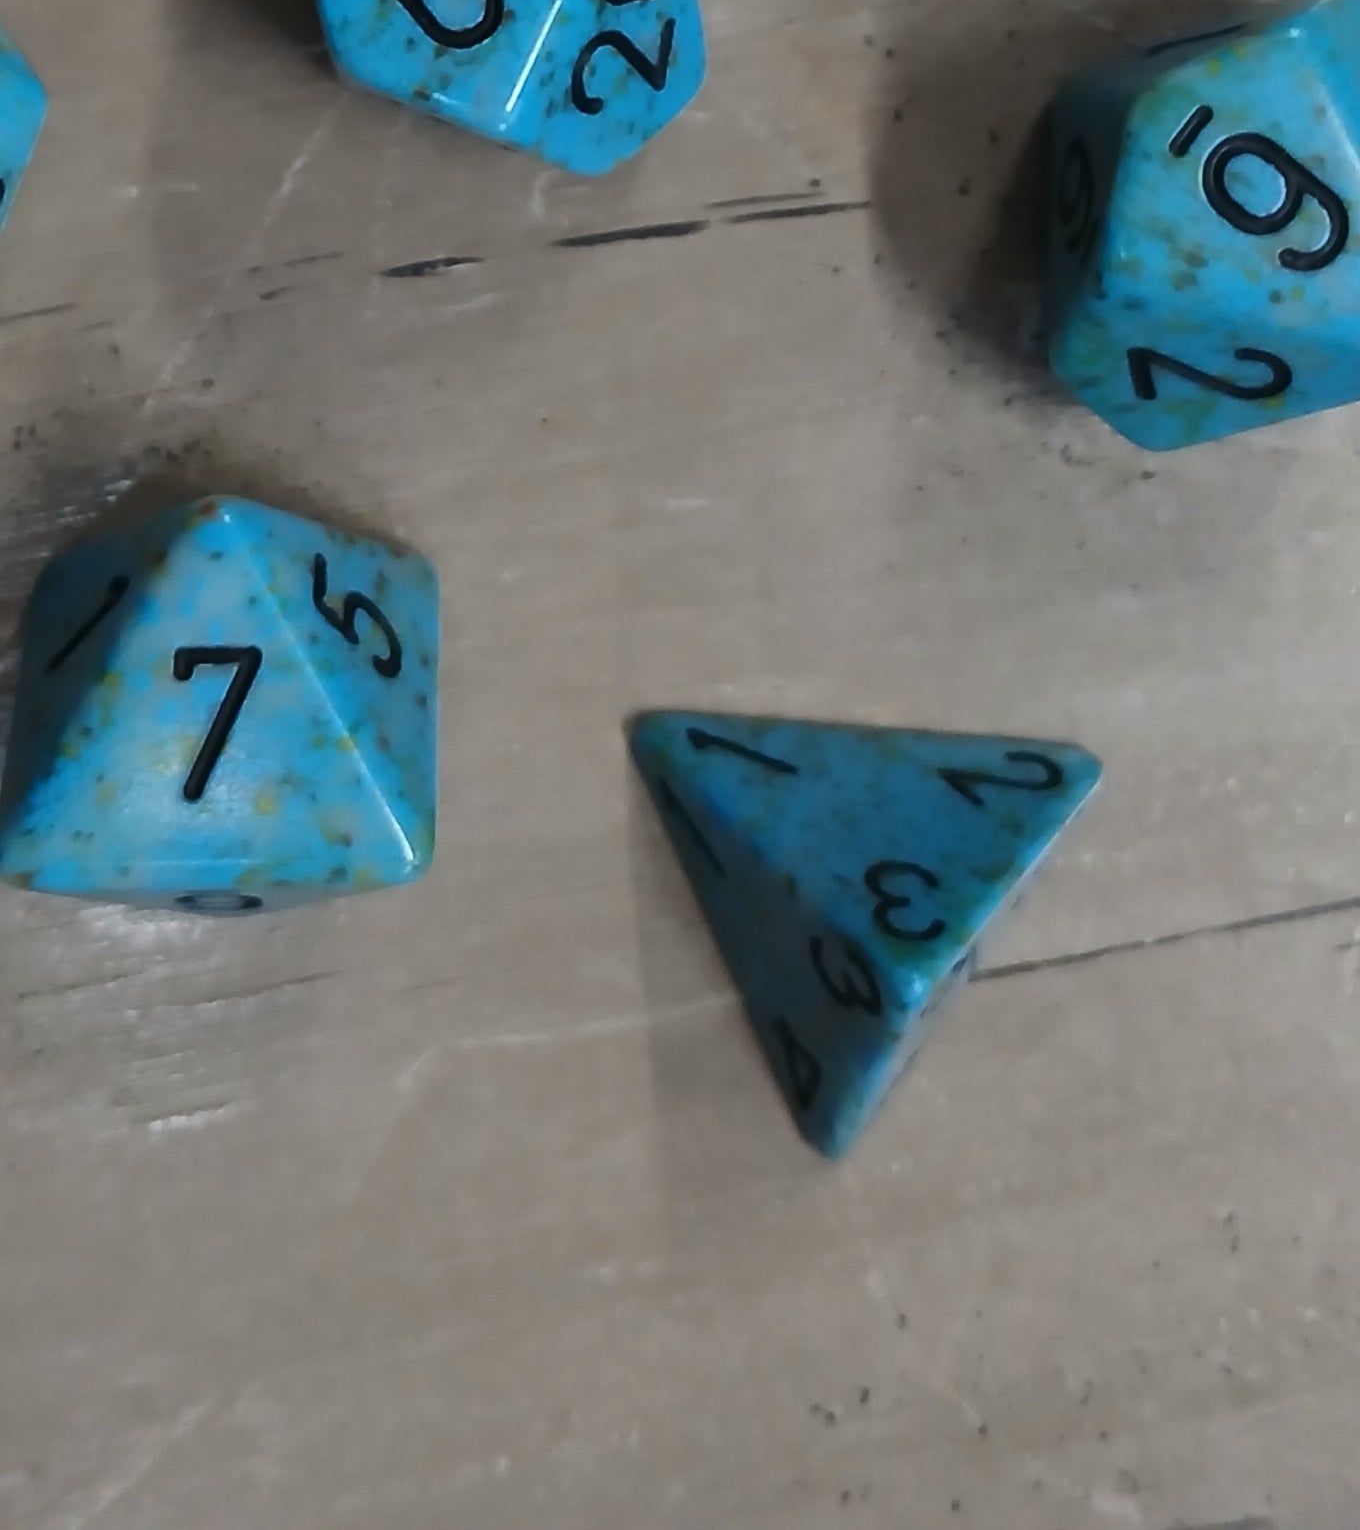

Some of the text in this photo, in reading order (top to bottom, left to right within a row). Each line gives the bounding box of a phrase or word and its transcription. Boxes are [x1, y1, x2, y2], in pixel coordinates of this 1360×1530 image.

[1126, 346, 1294, 401] 2
[311, 552, 403, 679] 5
[172, 644, 264, 804] 7
[685, 726, 800, 775] 1
[937, 749, 1064, 808] 2
[863, 859, 947, 943] 3
